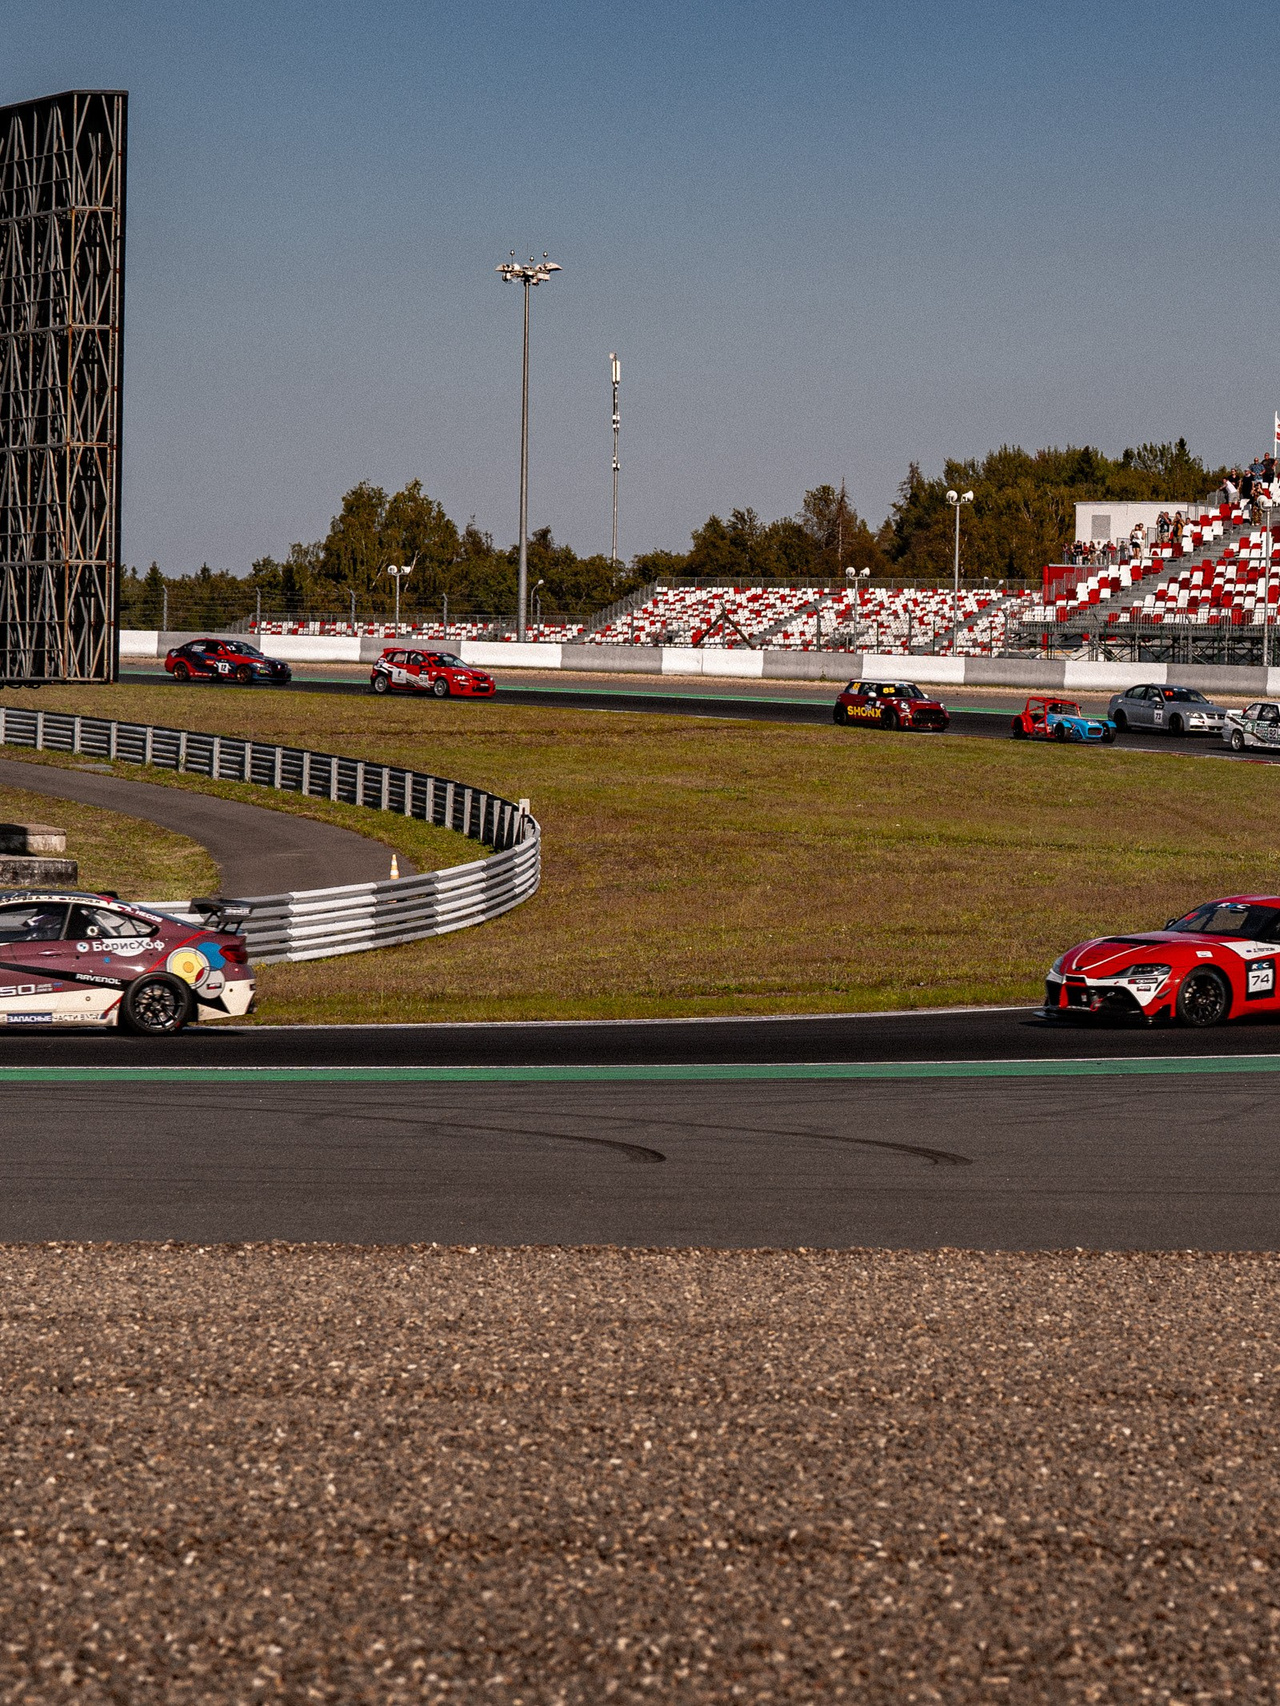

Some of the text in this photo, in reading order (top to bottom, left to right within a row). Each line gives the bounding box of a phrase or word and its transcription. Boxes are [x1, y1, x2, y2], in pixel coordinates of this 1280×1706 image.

[92, 939, 165, 952] БорисХоф
[76, 973, 122, 985] RAVENOL
[1251, 974, 1270, 986] 74
[8, 1015, 52, 1023] ЗАПАСНЫЕ
[52, 1014, 78, 1022] ЧАСТИ
